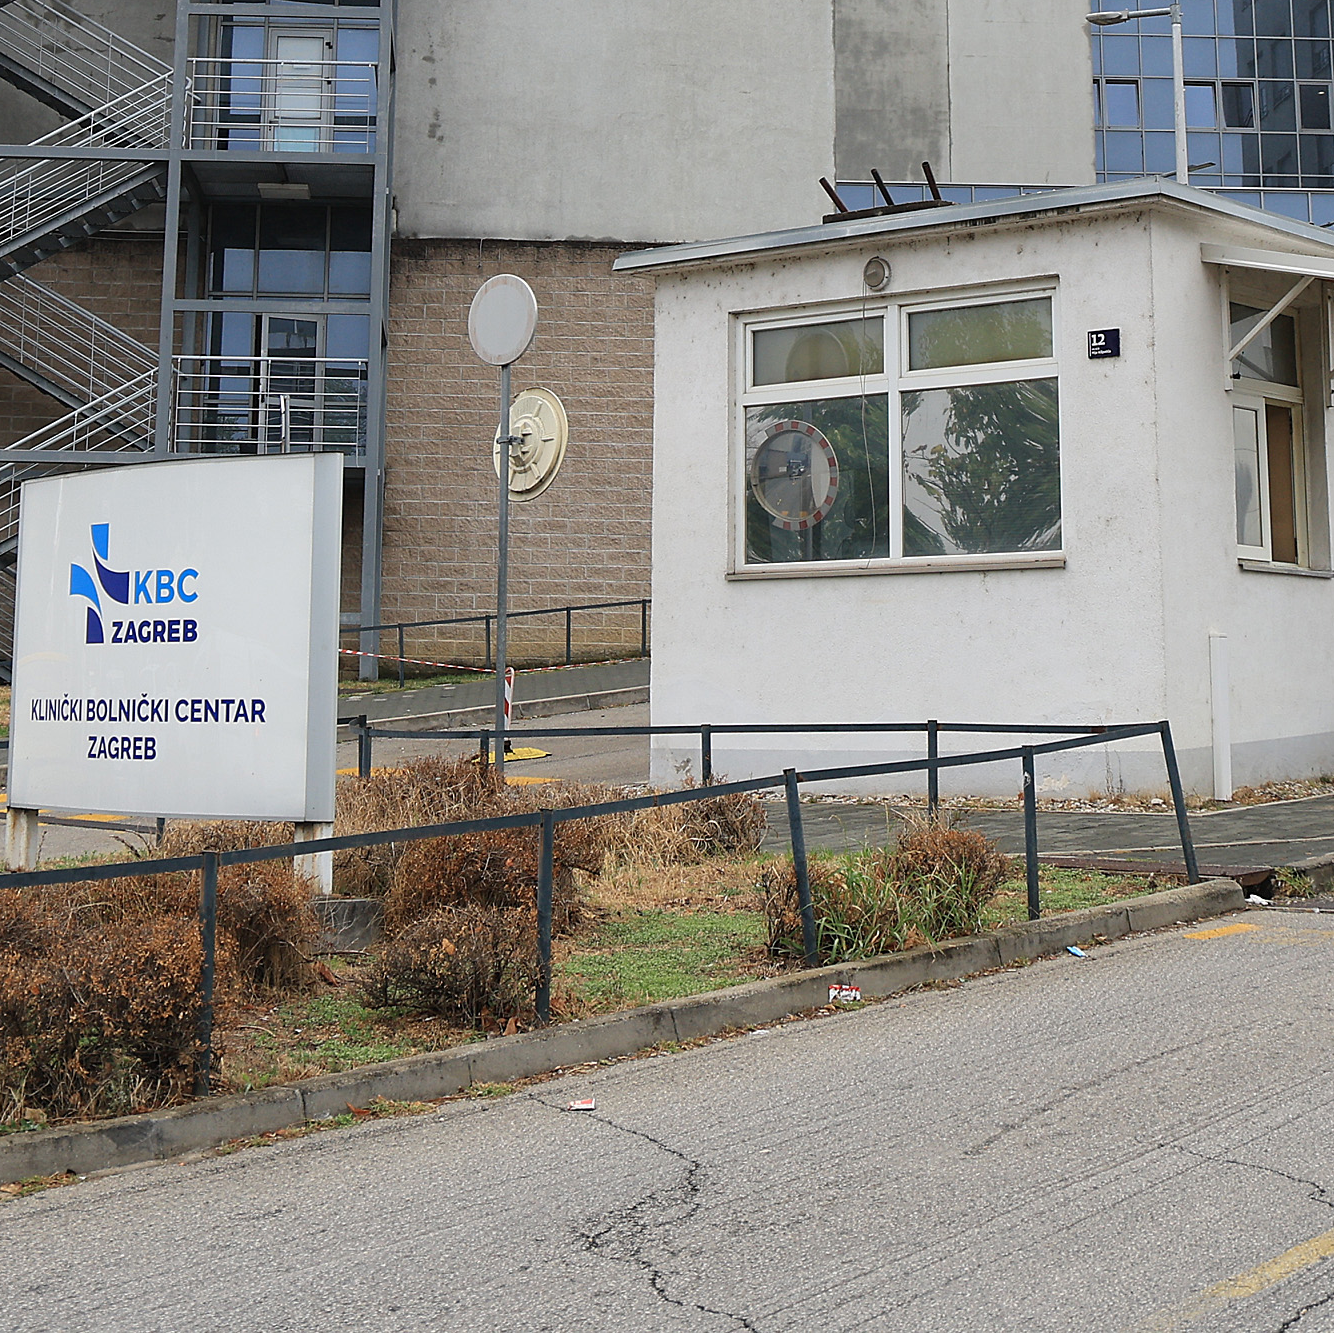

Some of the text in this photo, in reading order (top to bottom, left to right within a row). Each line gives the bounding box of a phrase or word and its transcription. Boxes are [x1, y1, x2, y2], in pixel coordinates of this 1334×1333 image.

[1091, 333, 1105, 346] 12
[134, 568, 199, 604] KBC
[111, 619, 198, 644] ZAGREB
[31, 693, 266, 723] KLINIČKI BOLNIČKI CENTAR
[87, 736, 156, 760] ZAGREB
